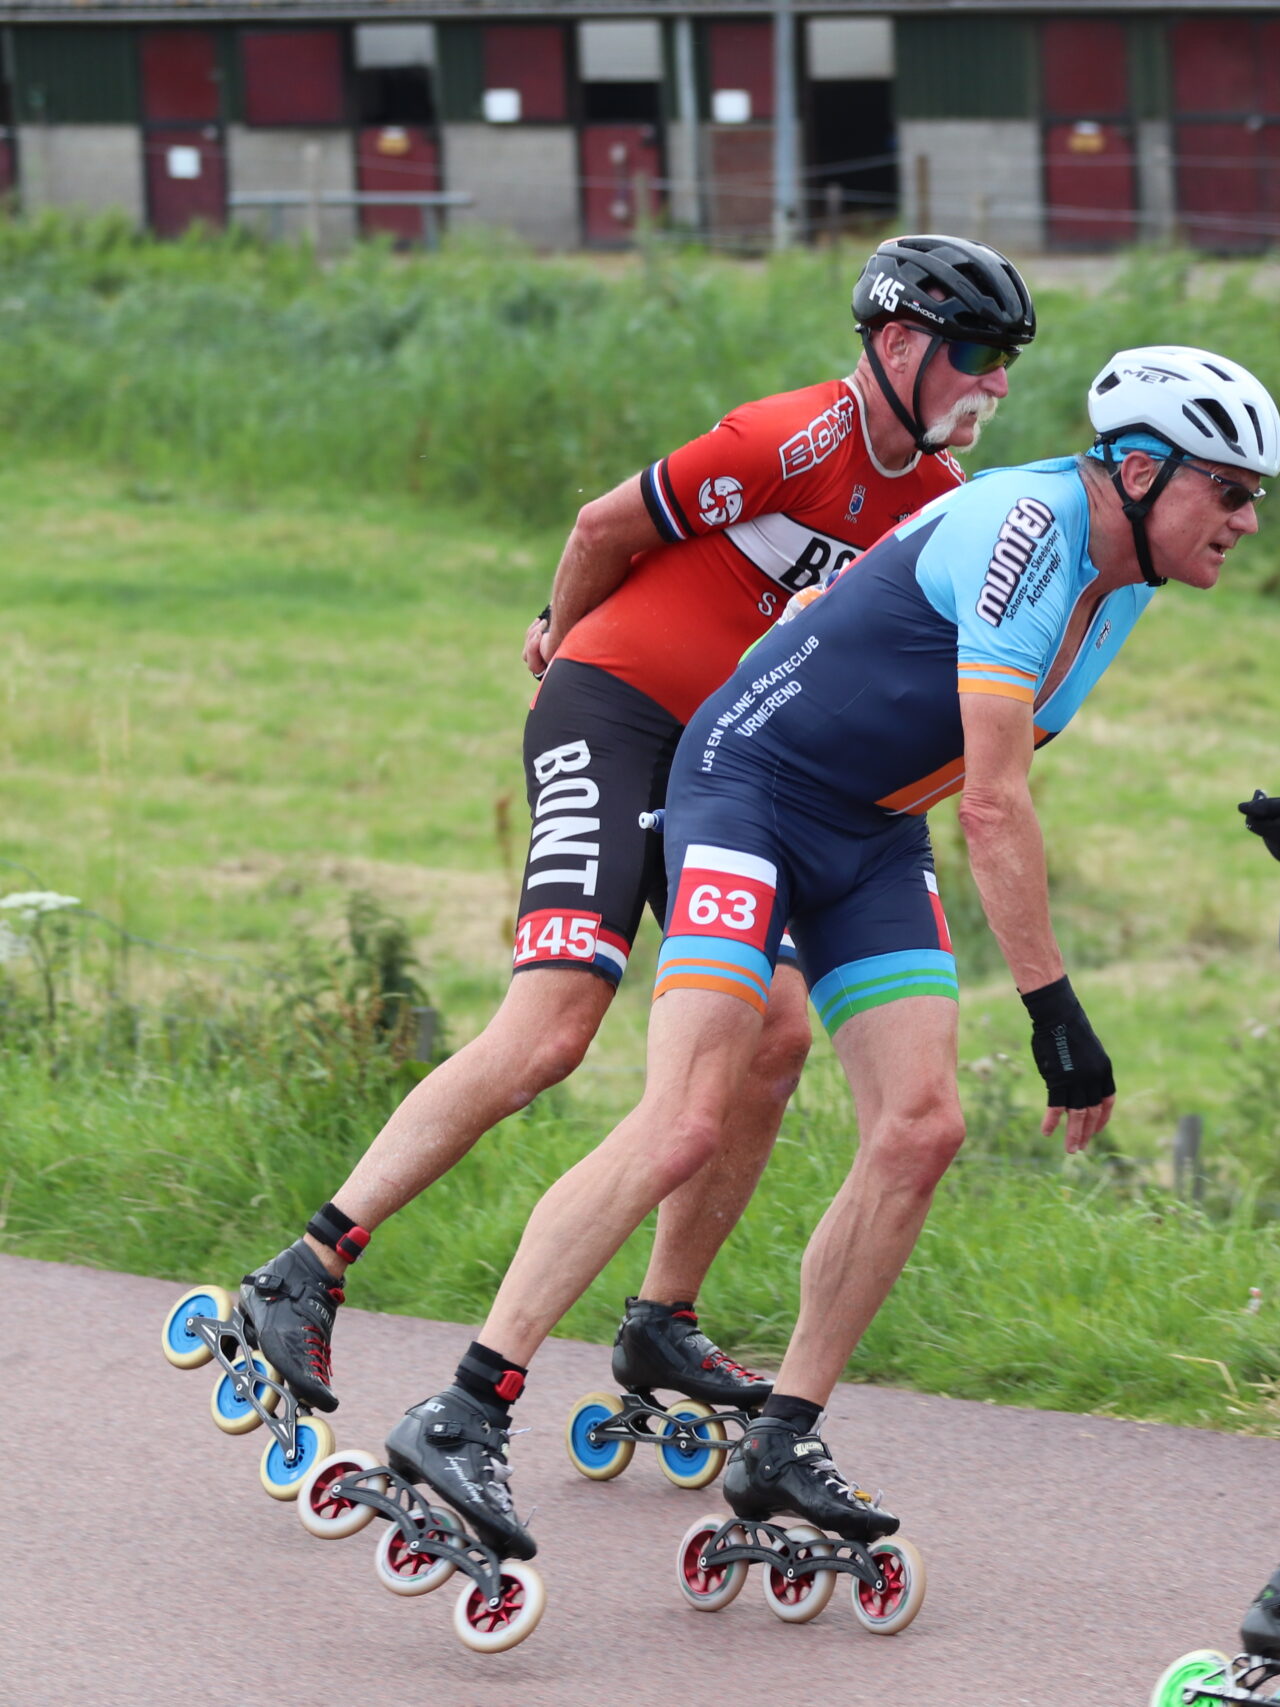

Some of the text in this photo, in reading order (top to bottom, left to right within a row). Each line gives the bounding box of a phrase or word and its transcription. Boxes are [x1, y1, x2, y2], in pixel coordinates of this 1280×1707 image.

[869, 272, 905, 313] 145
[1123, 369, 1175, 384] MET
[779, 395, 854, 480] BONT
[1026, 549, 1062, 608] Achterveld
[1027, 571, 1036, 584] en
[707, 727, 724, 747] EN
[702, 749, 715, 772] IJS
[527, 739, 600, 896] BONT
[688, 884, 757, 930] 63
